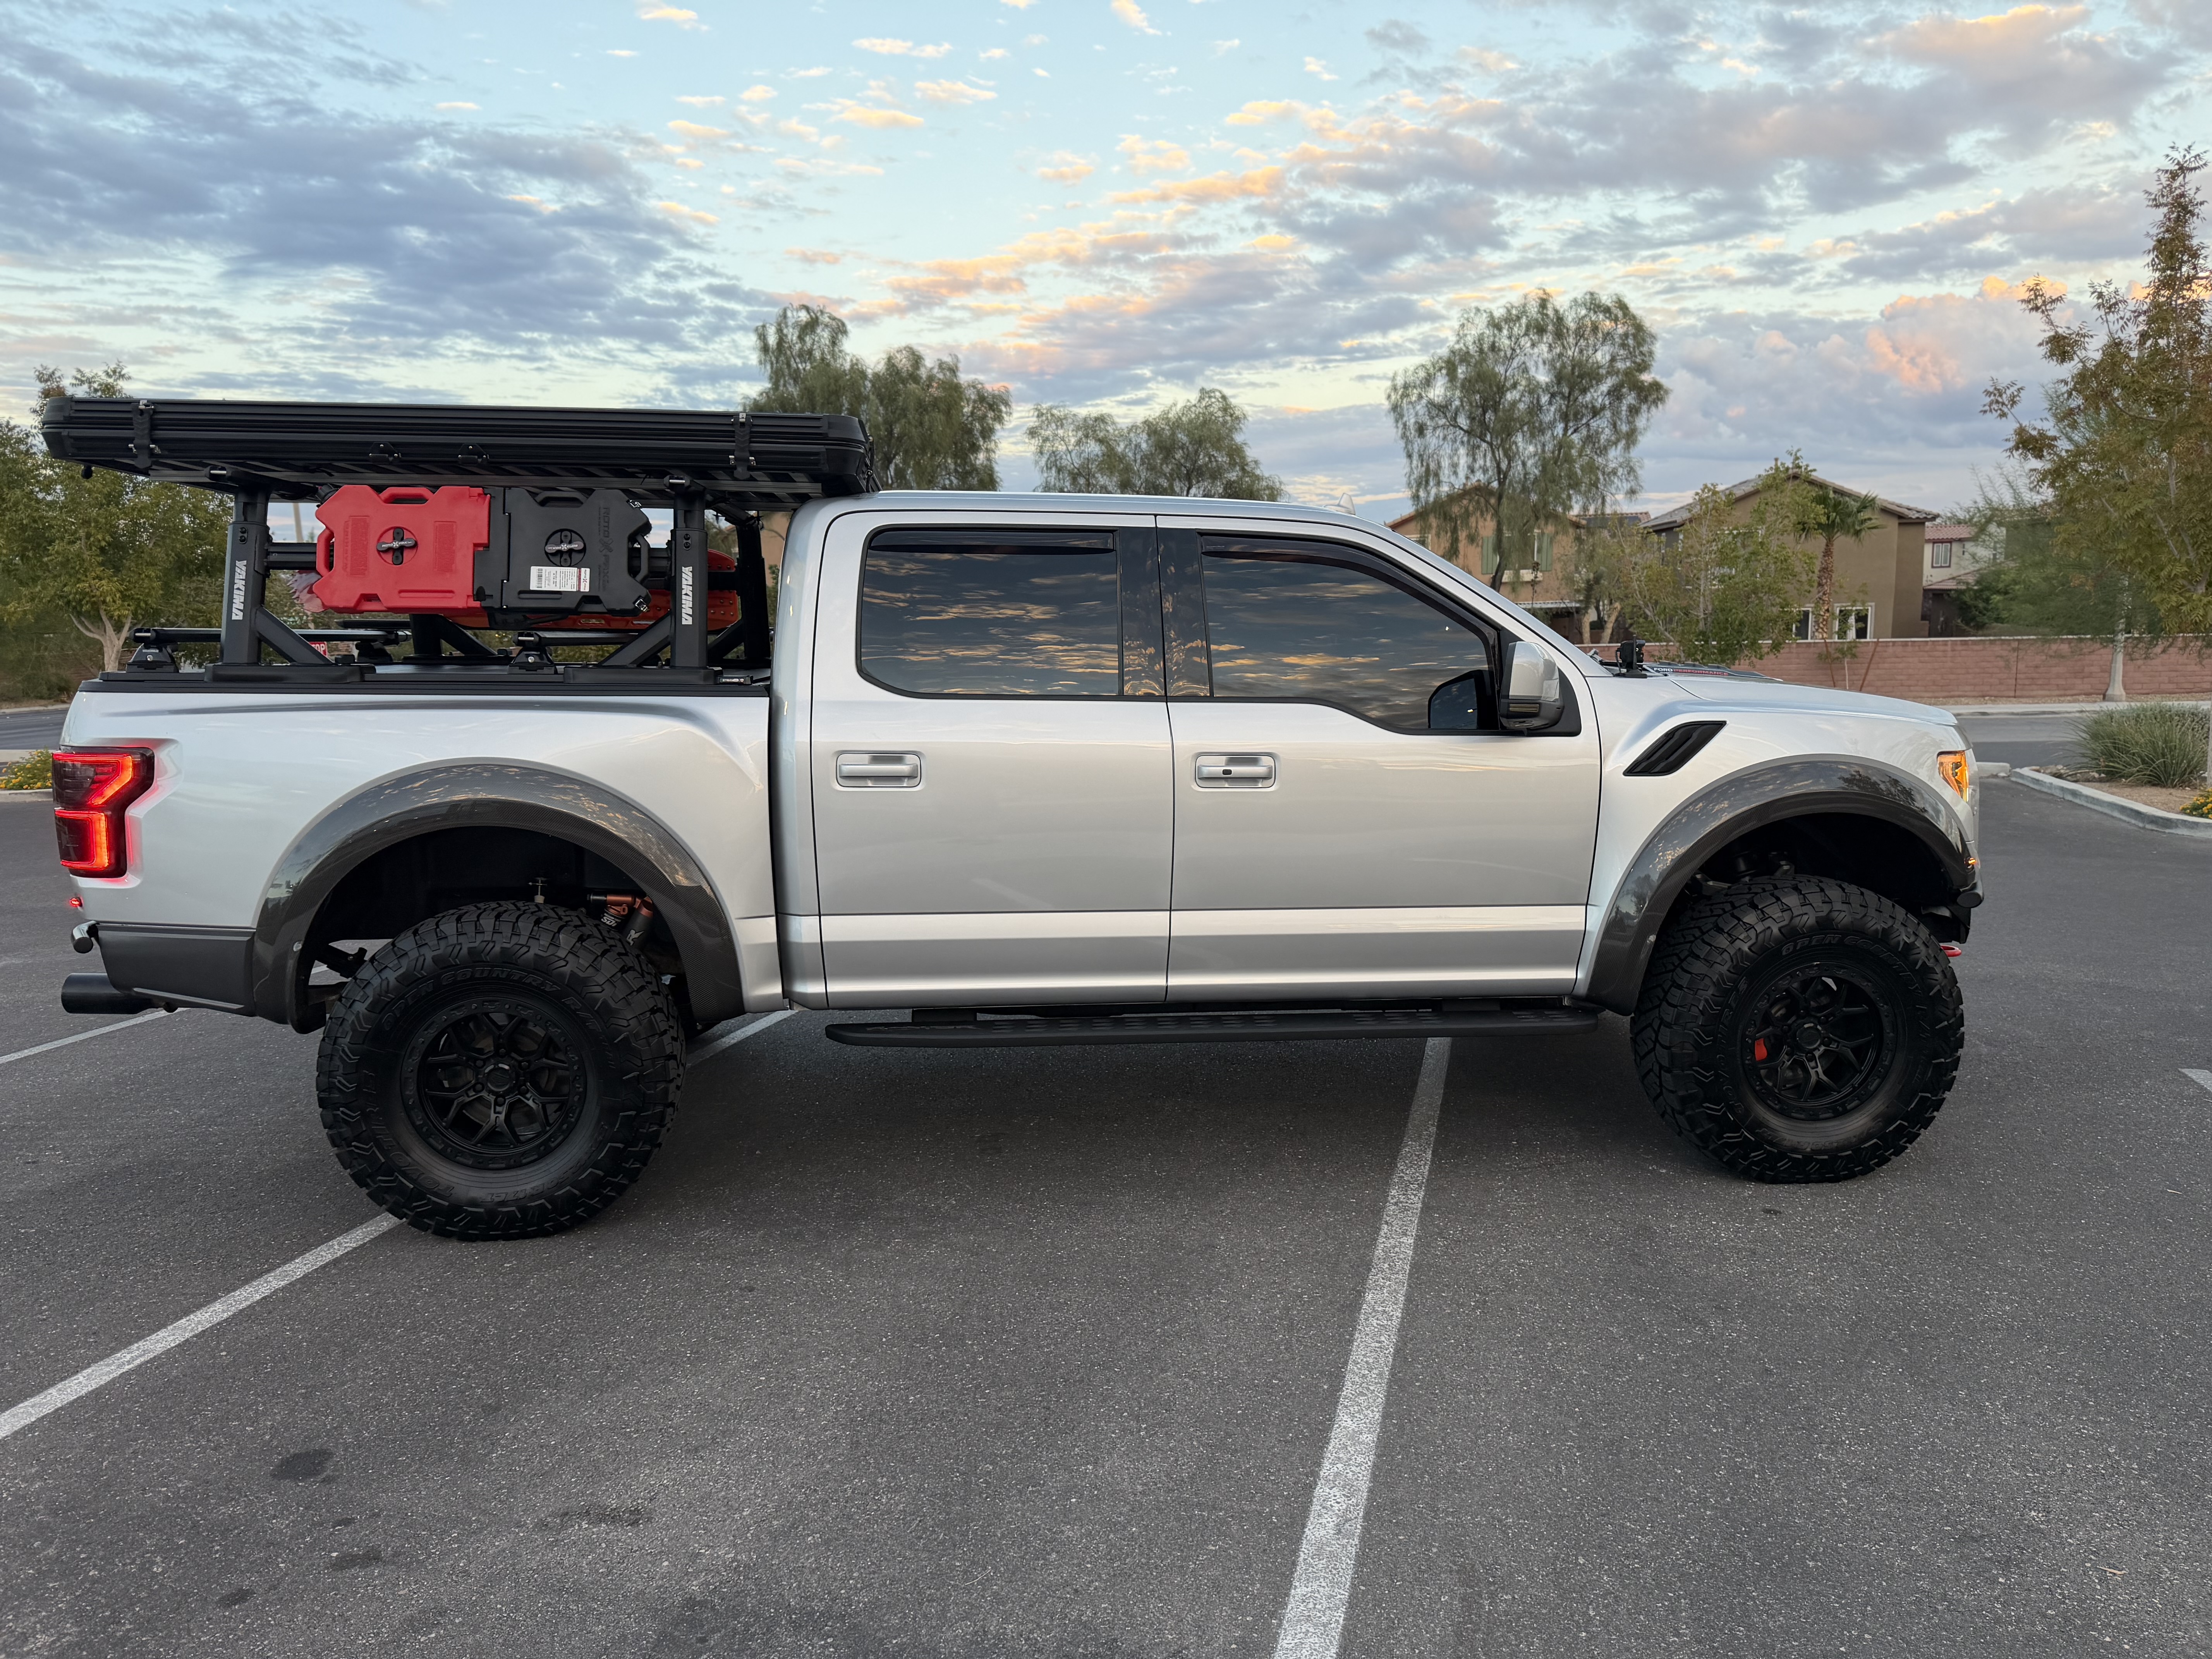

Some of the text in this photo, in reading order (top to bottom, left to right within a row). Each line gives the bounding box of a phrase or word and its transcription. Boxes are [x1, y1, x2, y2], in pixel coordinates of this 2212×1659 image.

[232, 560, 247, 620] YAKIMA
[682, 566, 692, 625] YAKIMA
[1780, 934, 1840, 957] OPEN
[382, 979, 435, 1030] OPEN
[440, 967, 562, 993] COUNTRY
[389, 1149, 455, 1198] TOYO
